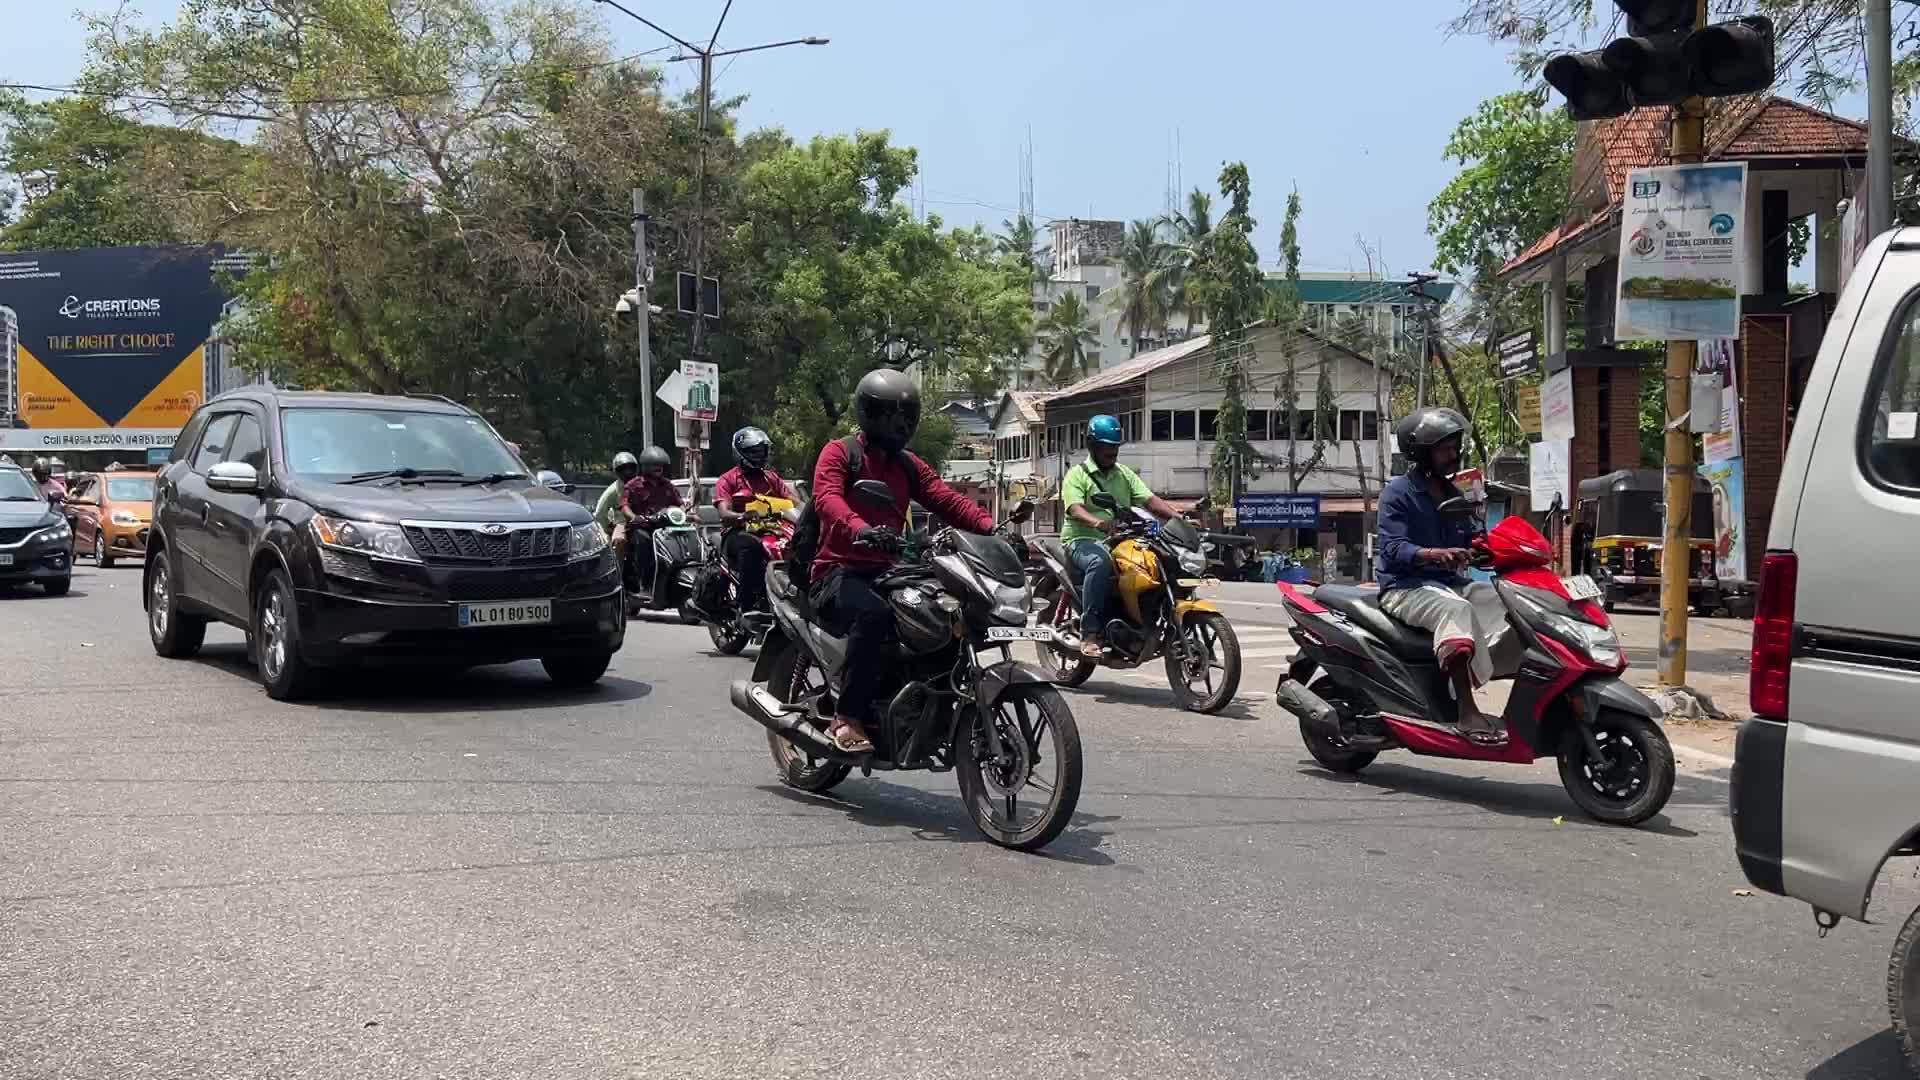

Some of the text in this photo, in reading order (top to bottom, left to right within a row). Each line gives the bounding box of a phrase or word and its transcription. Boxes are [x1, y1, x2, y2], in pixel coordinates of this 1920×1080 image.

[85, 298, 160, 312] CREATIONS
[48, 332, 175, 350] THE RIGHT CHOICE
[43, 435, 61, 445] Call
[470, 608, 487, 623] KL
[489, 607, 505, 622] 01
[526, 606, 549, 619] 500
